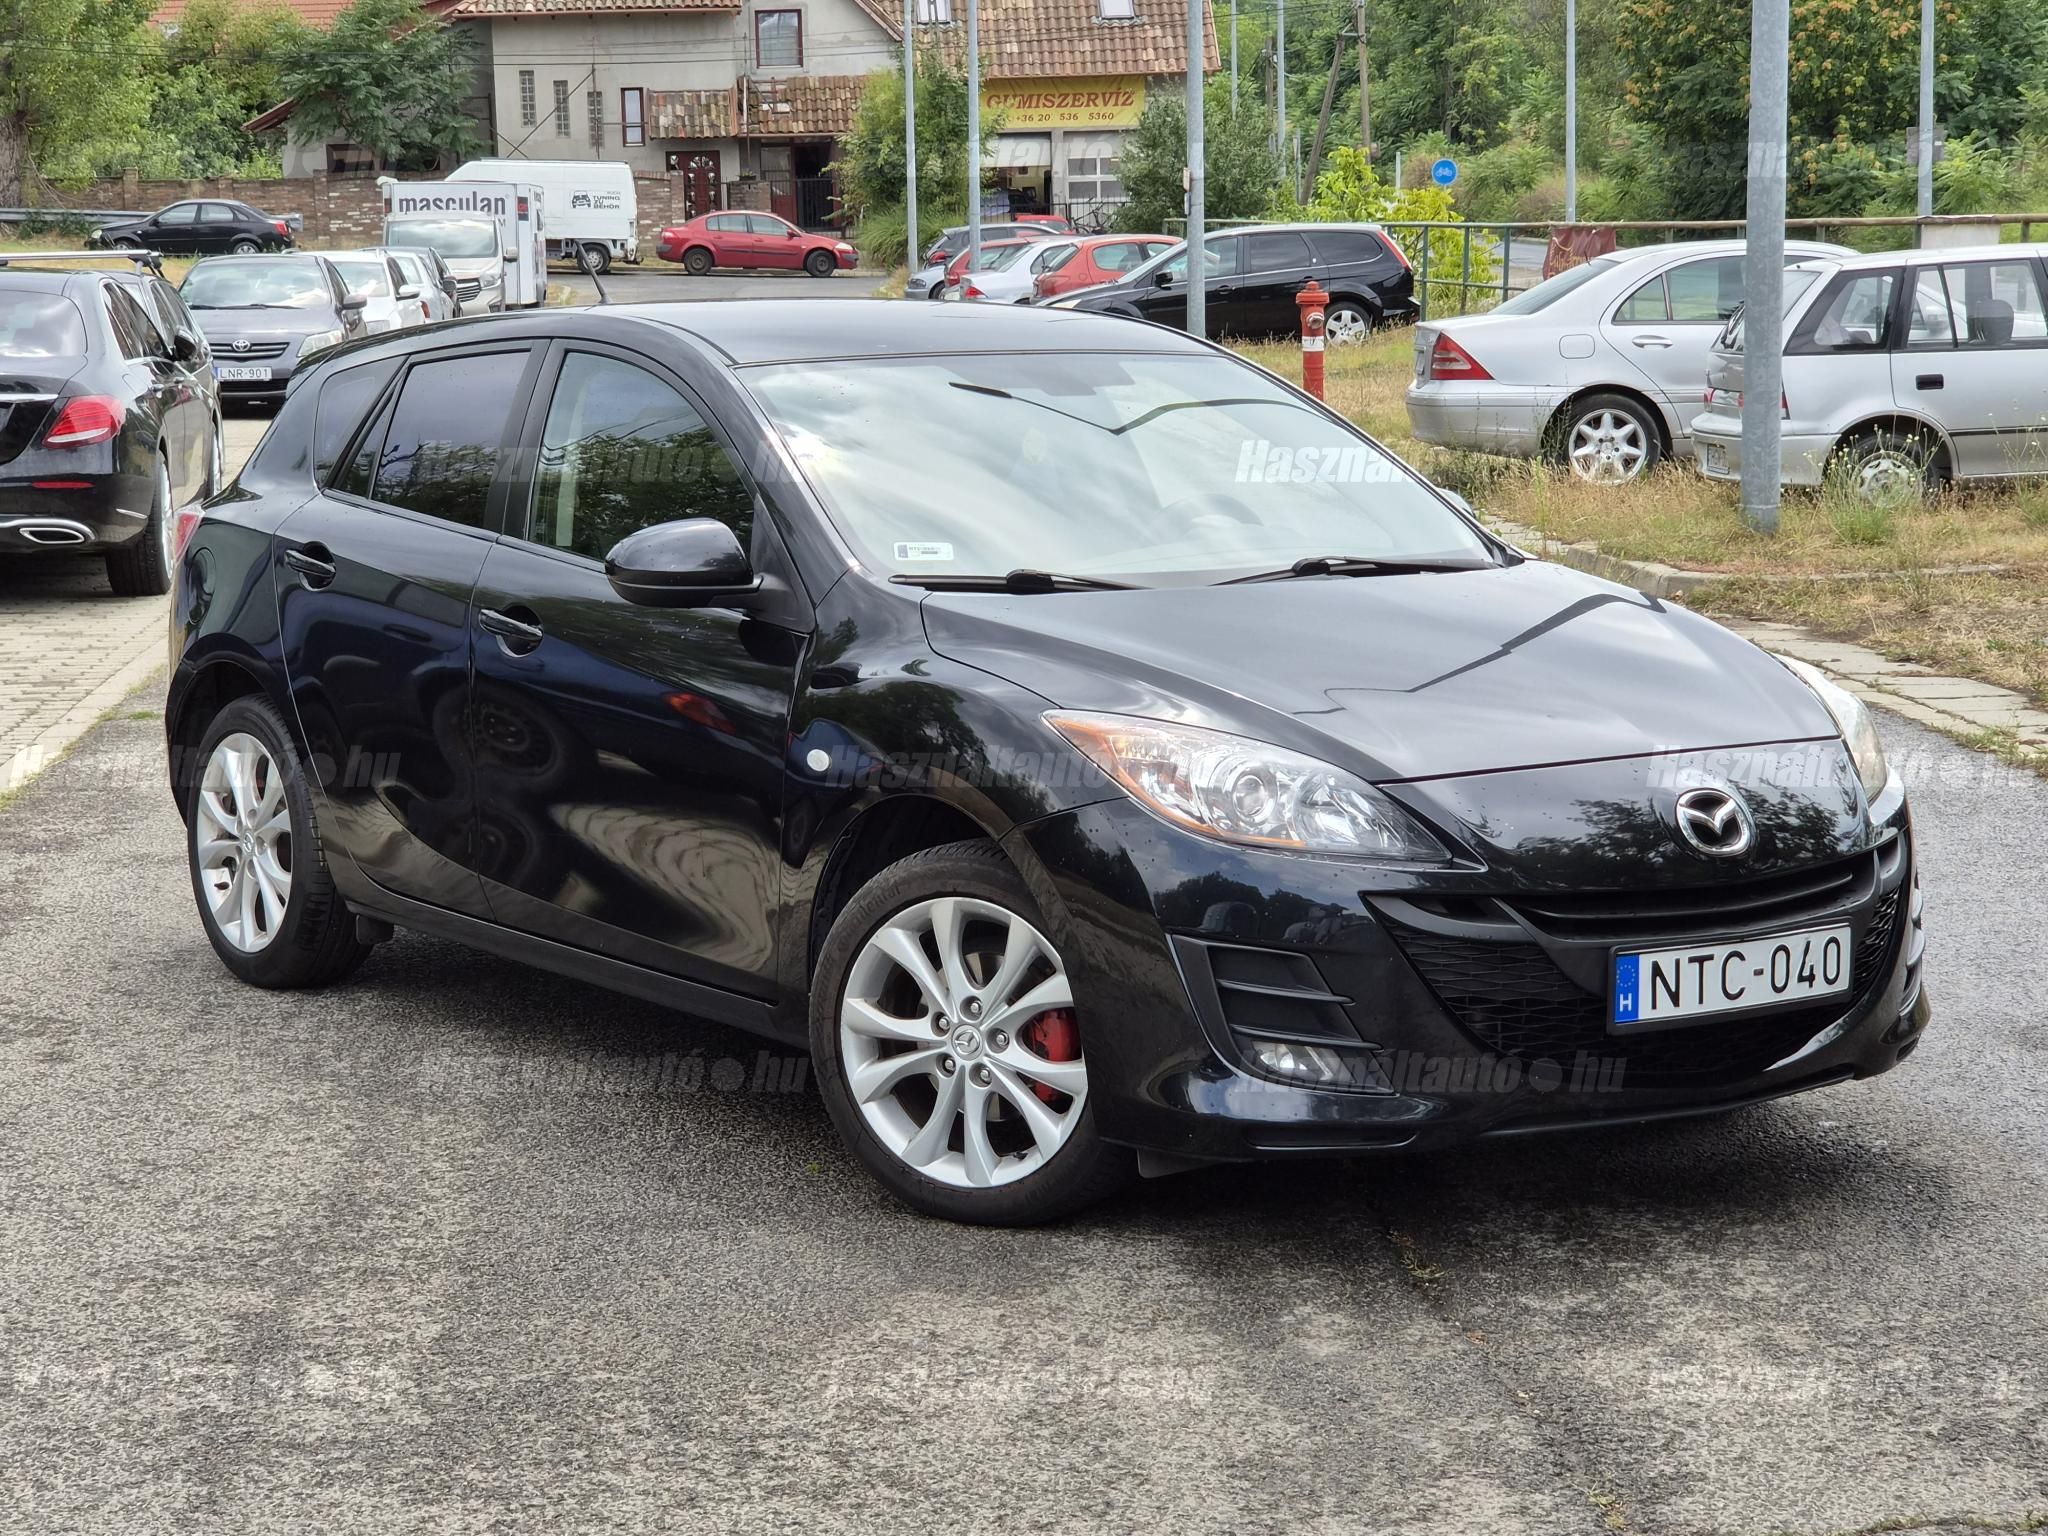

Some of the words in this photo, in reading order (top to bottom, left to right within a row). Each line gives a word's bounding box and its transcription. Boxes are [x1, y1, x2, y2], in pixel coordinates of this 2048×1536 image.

[1059, 112, 1079, 121] 536
[1088, 112, 1114, 121] 5360
[399, 191, 506, 215] masculan
[221, 368, 268, 379] LNR-901
[1619, 993, 1632, 1012] H
[1651, 936, 1840, 1010] NTC-040
